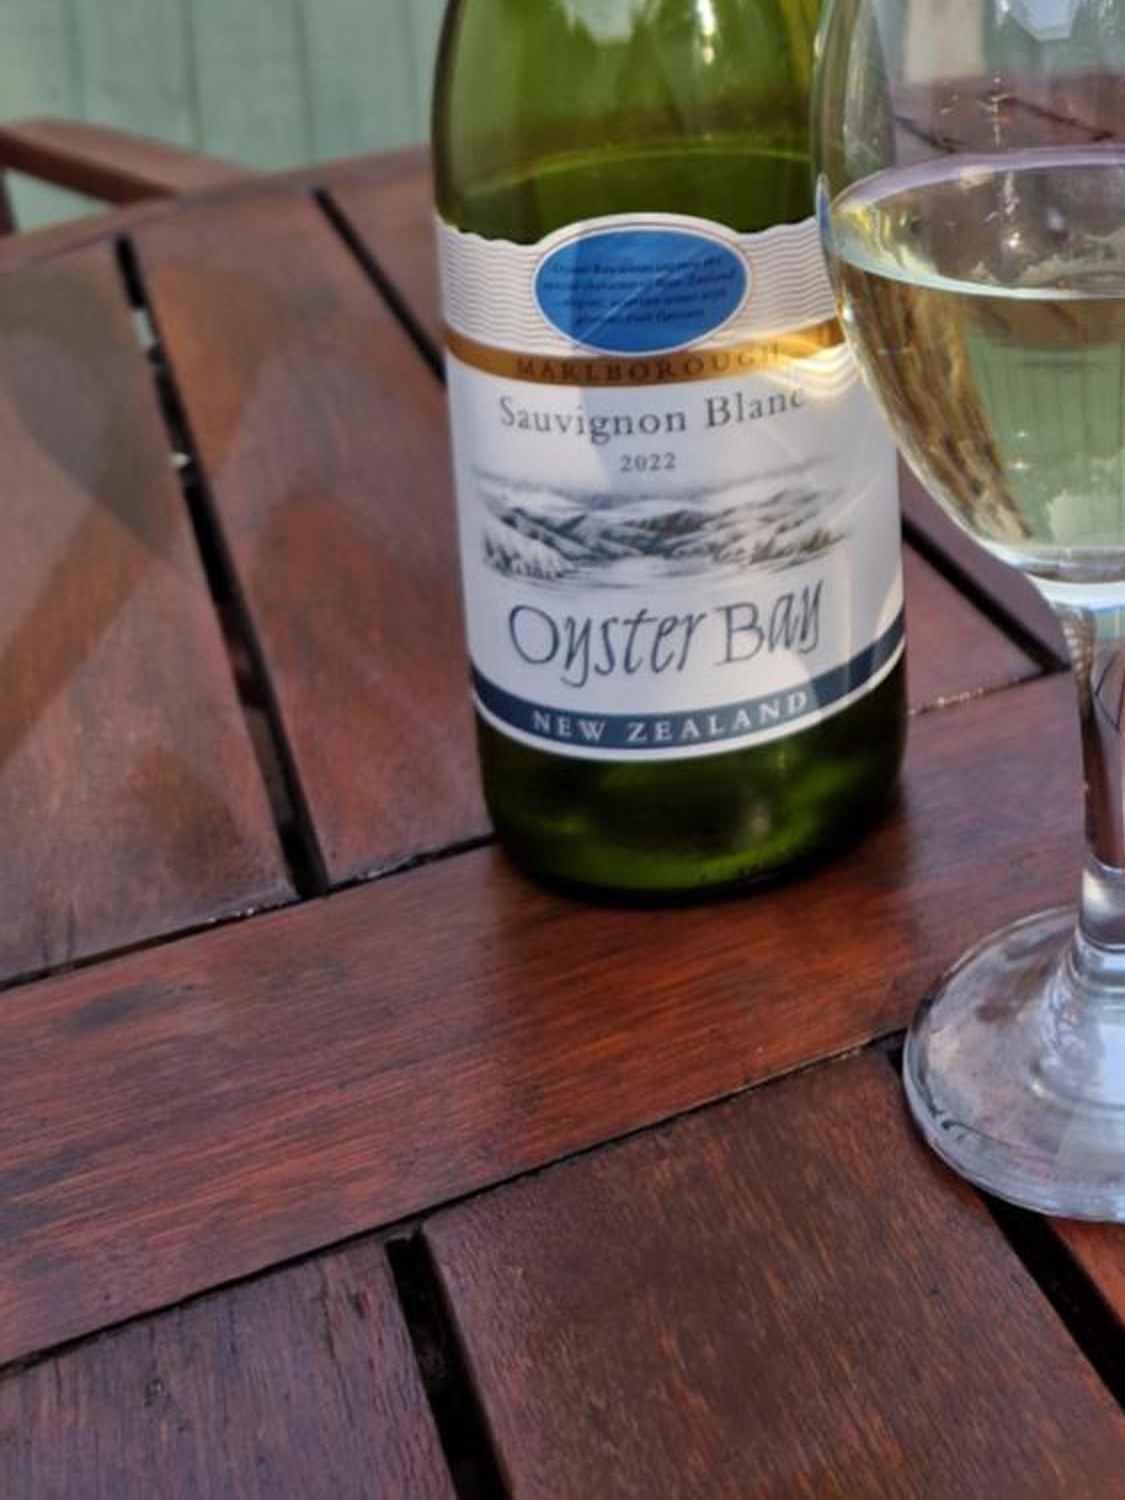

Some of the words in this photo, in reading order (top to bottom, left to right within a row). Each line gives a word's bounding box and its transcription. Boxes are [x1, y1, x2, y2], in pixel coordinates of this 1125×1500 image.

[499, 395, 686, 446] Sauvignon
[704, 391, 803, 428] Blanc
[619, 452, 676, 473] 2022
[508, 604, 706, 688] Oyster
[714, 579, 823, 667] Bay
[531, 710, 605, 740] NEW
[626, 690, 807, 743] ZEALAND
